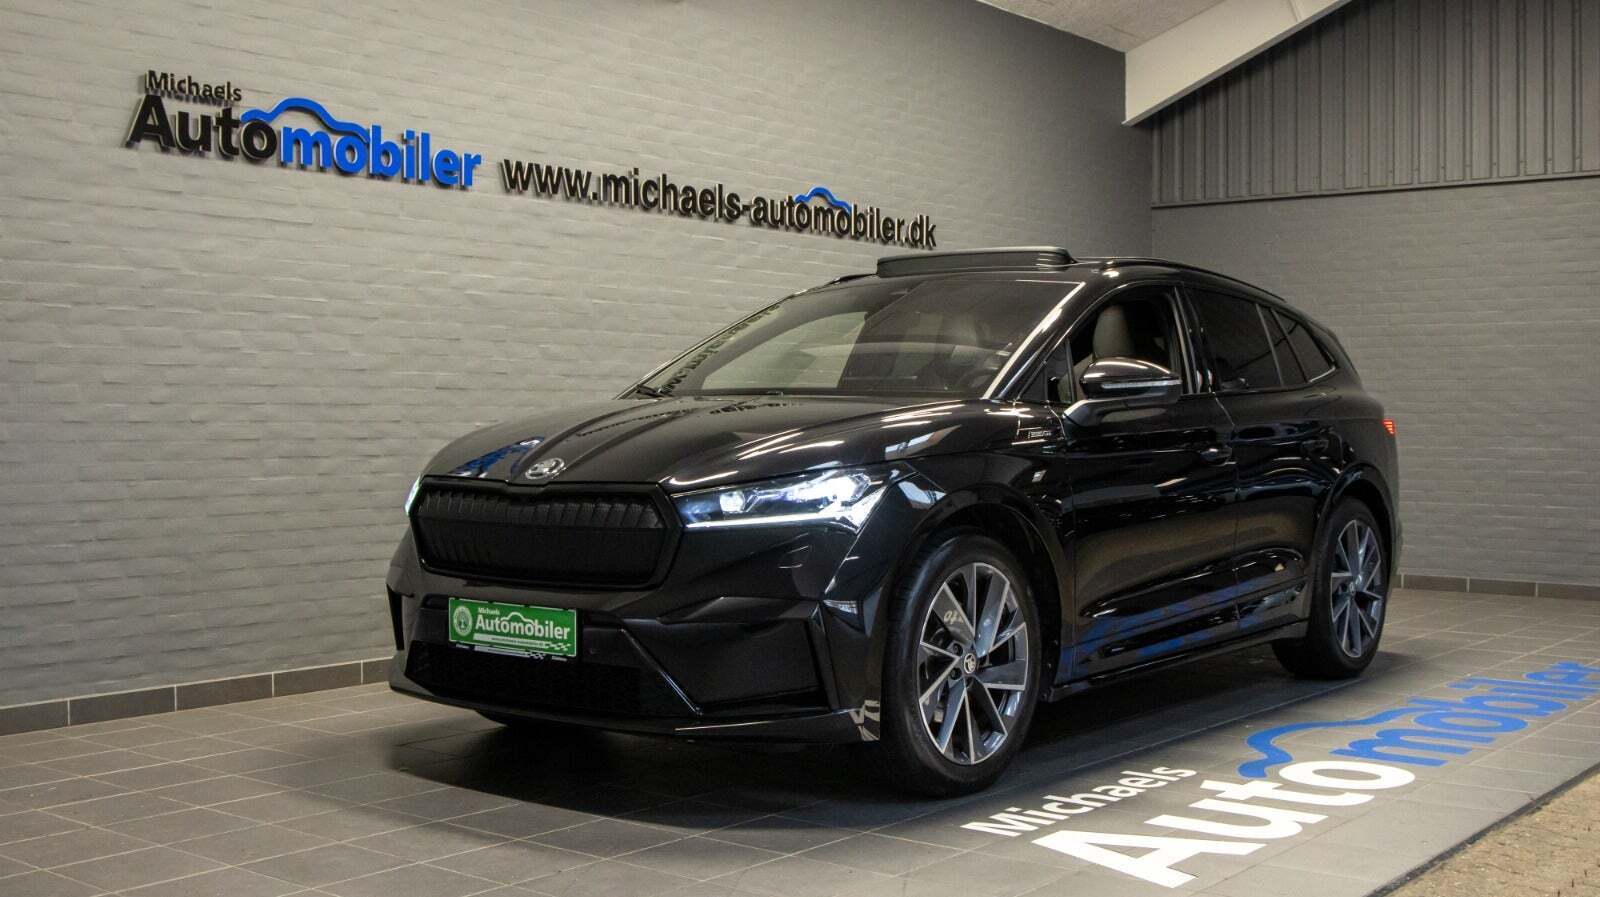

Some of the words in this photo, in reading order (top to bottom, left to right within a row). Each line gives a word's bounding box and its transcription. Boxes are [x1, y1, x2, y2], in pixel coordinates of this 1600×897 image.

[145, 70, 242, 101] Michaels
[126, 94, 481, 187] Automobiler
[502, 159, 936, 247] www.michaels-automobiler.dk
[475, 614, 570, 640] Automobiler
[478, 607, 500, 615] Michaels
[960, 766, 1198, 837] Michaels
